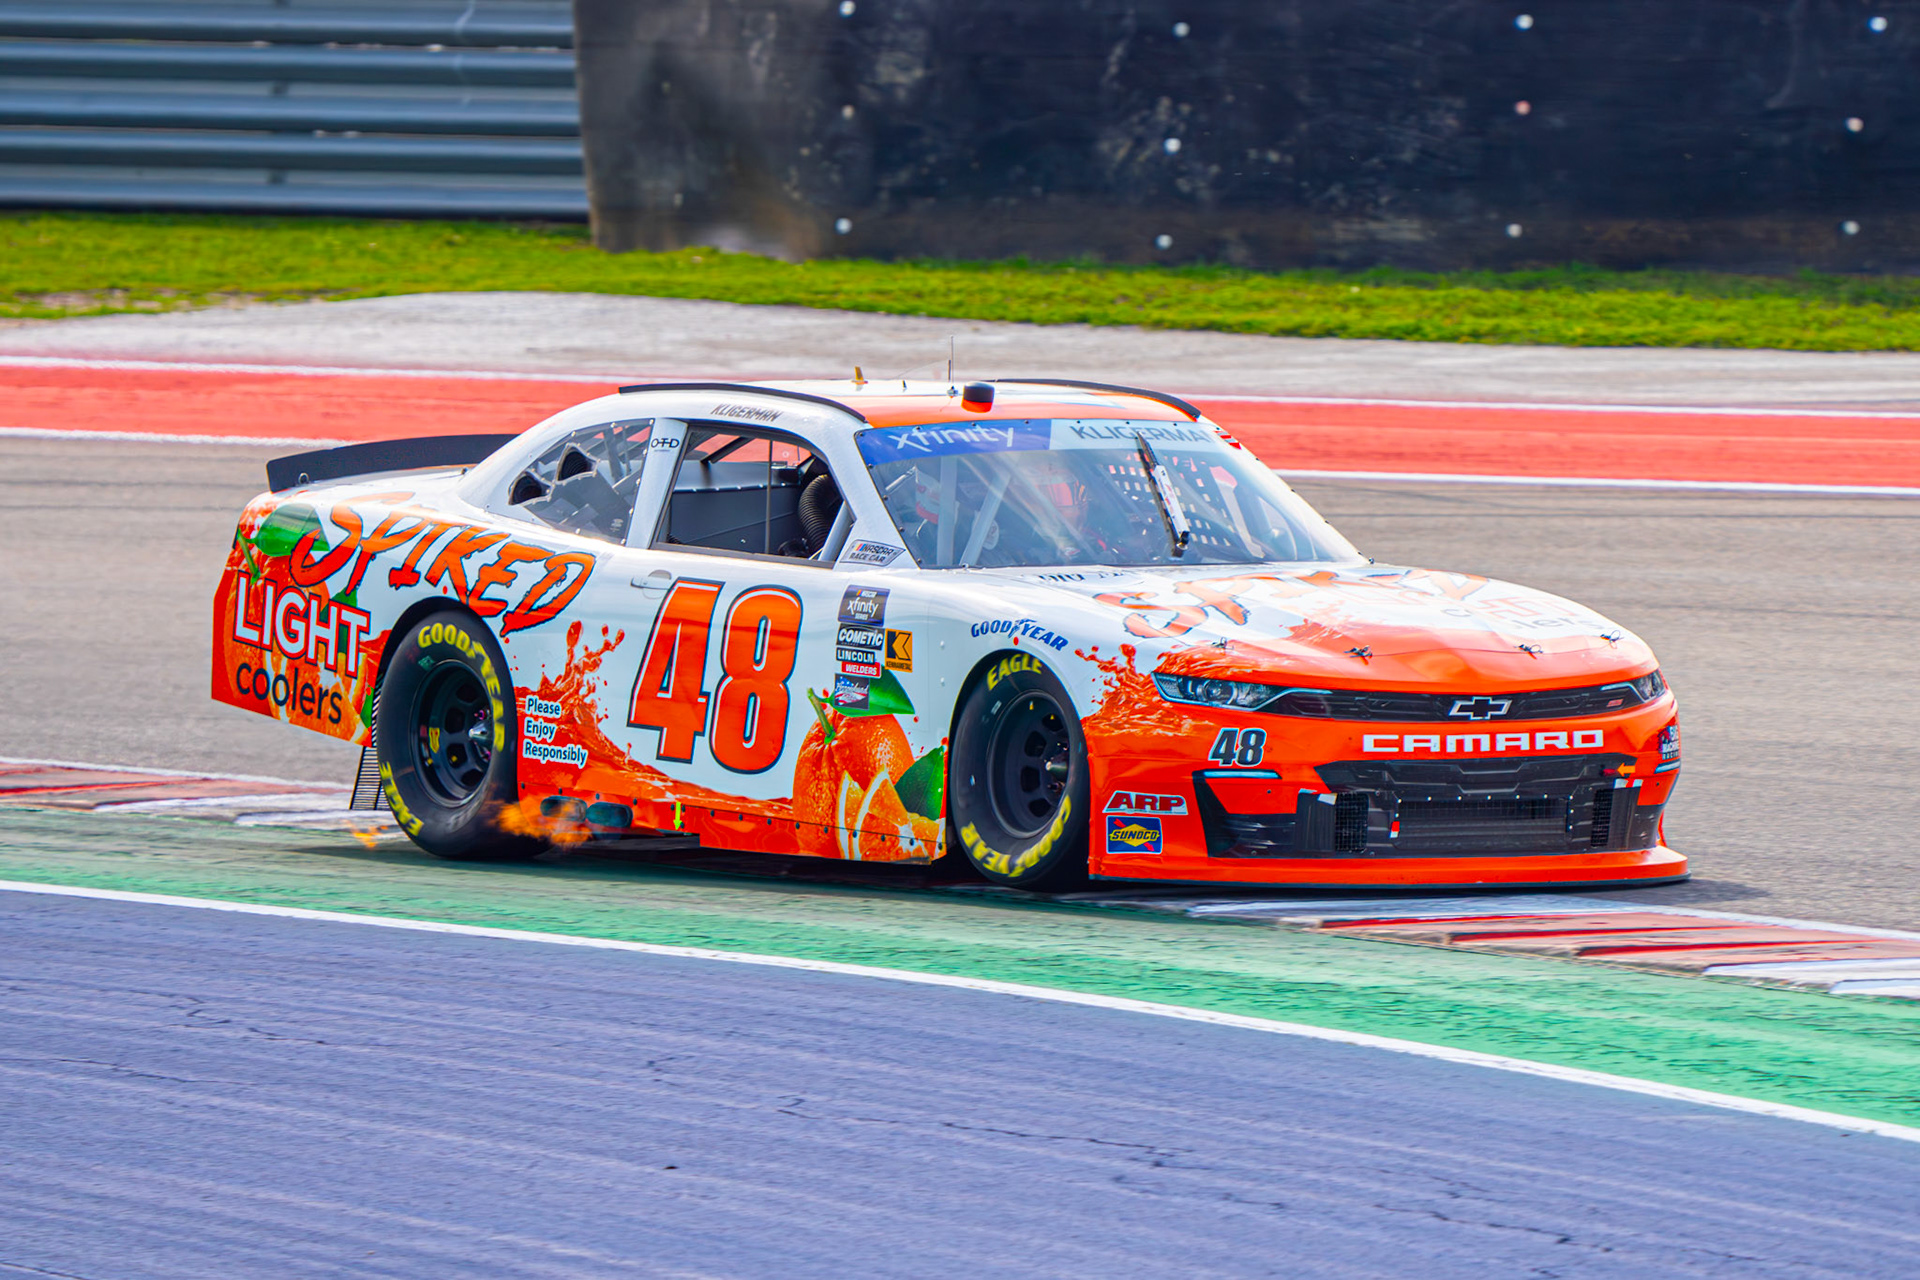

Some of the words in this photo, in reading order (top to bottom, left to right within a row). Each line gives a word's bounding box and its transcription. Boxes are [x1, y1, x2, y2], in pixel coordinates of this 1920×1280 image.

[711, 403, 784, 422] KLIGERMAN
[888, 424, 1014, 452] xfinity
[848, 552, 868, 560] RACE
[869, 553, 886, 563] CAR
[861, 543, 895, 556] NASCAR
[288, 492, 597, 637] SPIKED
[847, 597, 879, 618] xfinity
[233, 569, 372, 680] LIGHT
[971, 618, 1069, 651] GOODYEAR
[838, 628, 884, 647] COMETIC
[837, 650, 874, 664] LINCOLN
[627, 577, 804, 775] 48
[845, 664, 877, 676] WELDERS
[987, 653, 1043, 691] EAGLE
[236, 662, 342, 724] coolers
[527, 697, 561, 716] Please
[526, 719, 556, 740] Enjoy
[1208, 727, 1267, 767] 48
[1363, 730, 1603, 752] CAMARO
[524, 740, 587, 766] Responsibly
[1106, 791, 1185, 812] ARP
[1111, 829, 1158, 841] SUNOCO
